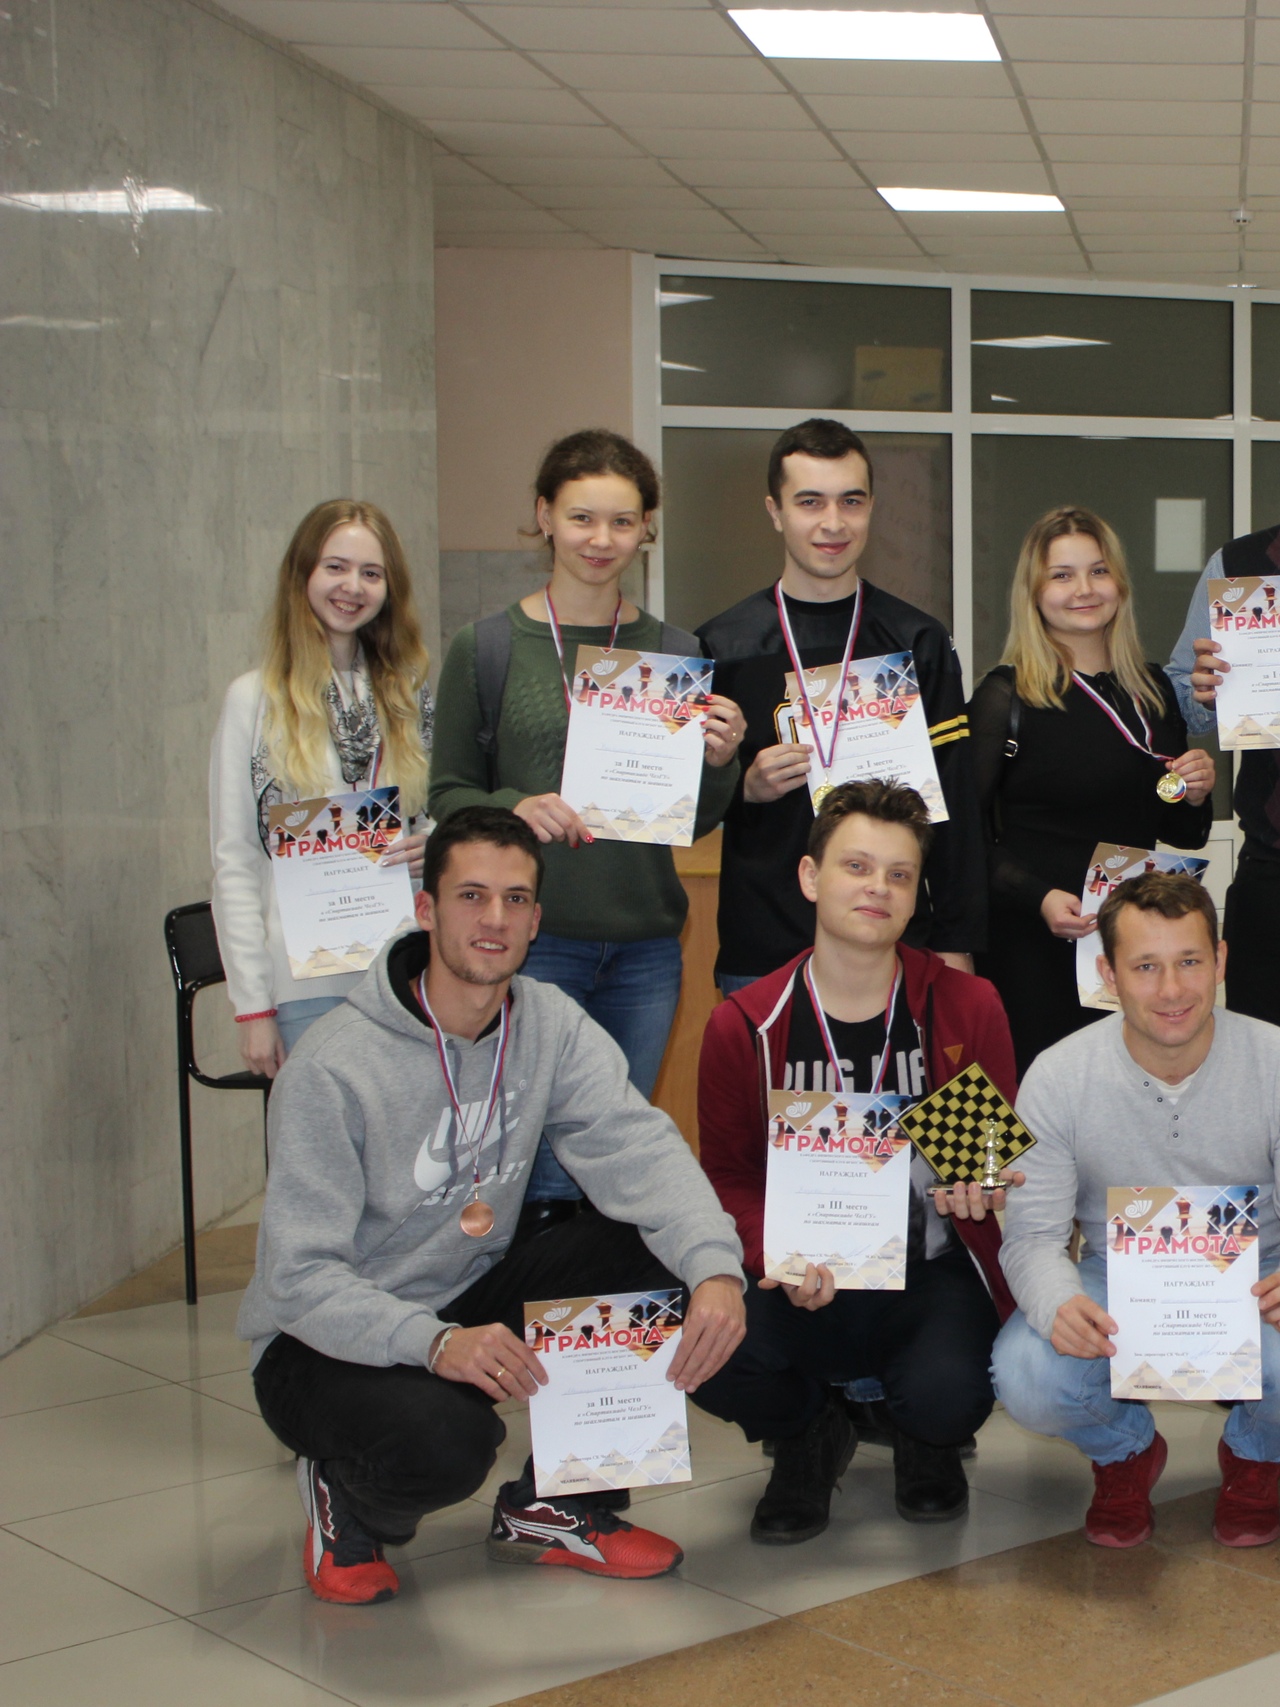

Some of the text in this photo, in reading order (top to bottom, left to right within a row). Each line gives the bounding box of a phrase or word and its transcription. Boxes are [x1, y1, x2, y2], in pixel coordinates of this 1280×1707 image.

[587, 691, 691, 719] ГРАМОТА
[815, 697, 908, 726] РАМОТА
[619, 730, 665, 740] НАГРАЖДАЕТ
[847, 730, 889, 742] НАГРАЖДАЕТ
[626, 760, 639, 768] III
[286, 829, 388, 857] ГРАМОТА
[324, 866, 369, 876] НАГРАЖДАЕТ
[339, 896, 351, 904] III
[355, 895, 375, 903] место
[784, 1135, 893, 1155] ГРАМОТА
[829, 1201, 842, 1209] III
[1124, 1235, 1240, 1255] ГРАМОТА
[1177, 1311, 1189, 1319] III
[543, 1326, 664, 1353] ГРАМОТА
[585, 1364, 638, 1375] НАГРАЖДАЕТ
[600, 1397, 614, 1406] III
